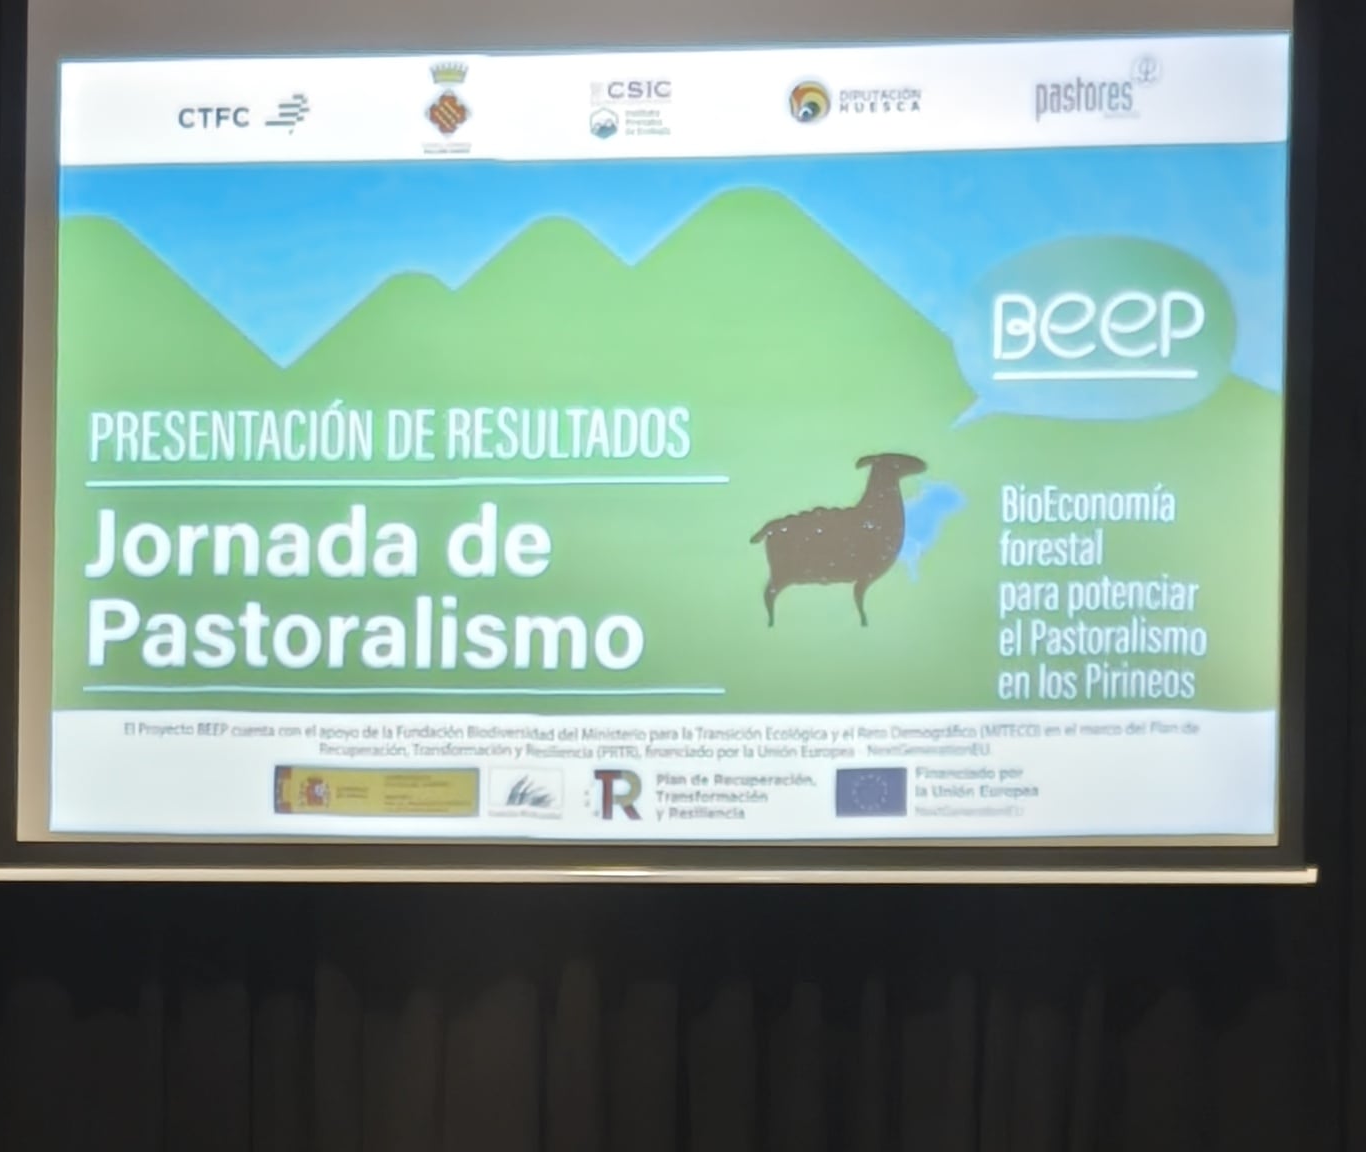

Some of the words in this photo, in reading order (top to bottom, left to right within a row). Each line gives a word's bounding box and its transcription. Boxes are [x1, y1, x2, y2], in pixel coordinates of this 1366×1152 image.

[607, 80, 672, 99] CSIC
[839, 88, 922, 102] DIPUTACIÓN
[839, 101, 921, 113] HUESCA
[1035, 76, 1133, 123] pastores
[178, 107, 250, 129] CTFC
[89, 400, 373, 463] PRESENTACIÓN
[386, 406, 436, 462] DE
[447, 405, 692, 461] RESULTADOS
[1001, 481, 1176, 523] BioEconomía
[84, 503, 418, 578] Jornada
[446, 502, 552, 578] de
[999, 528, 1103, 566] forestal
[999, 581, 1059, 619] para
[1067, 573, 1200, 619] potenciar
[87, 594, 645, 670] Pastoralismo
[999, 618, 1022, 657] el
[1031, 615, 1207, 657] Pastoralismo
[998, 670, 1030, 700] en
[1038, 663, 1078, 700] los
[1086, 661, 1196, 700] Pirineos
[139, 723, 194, 737] Proyecto
[305, 724, 317, 737] el
[363, 725, 379, 738] de
[383, 725, 393, 738] la
[682, 727, 693, 741] la
[656, 773, 686, 786] Plan
[691, 773, 709, 786] de
